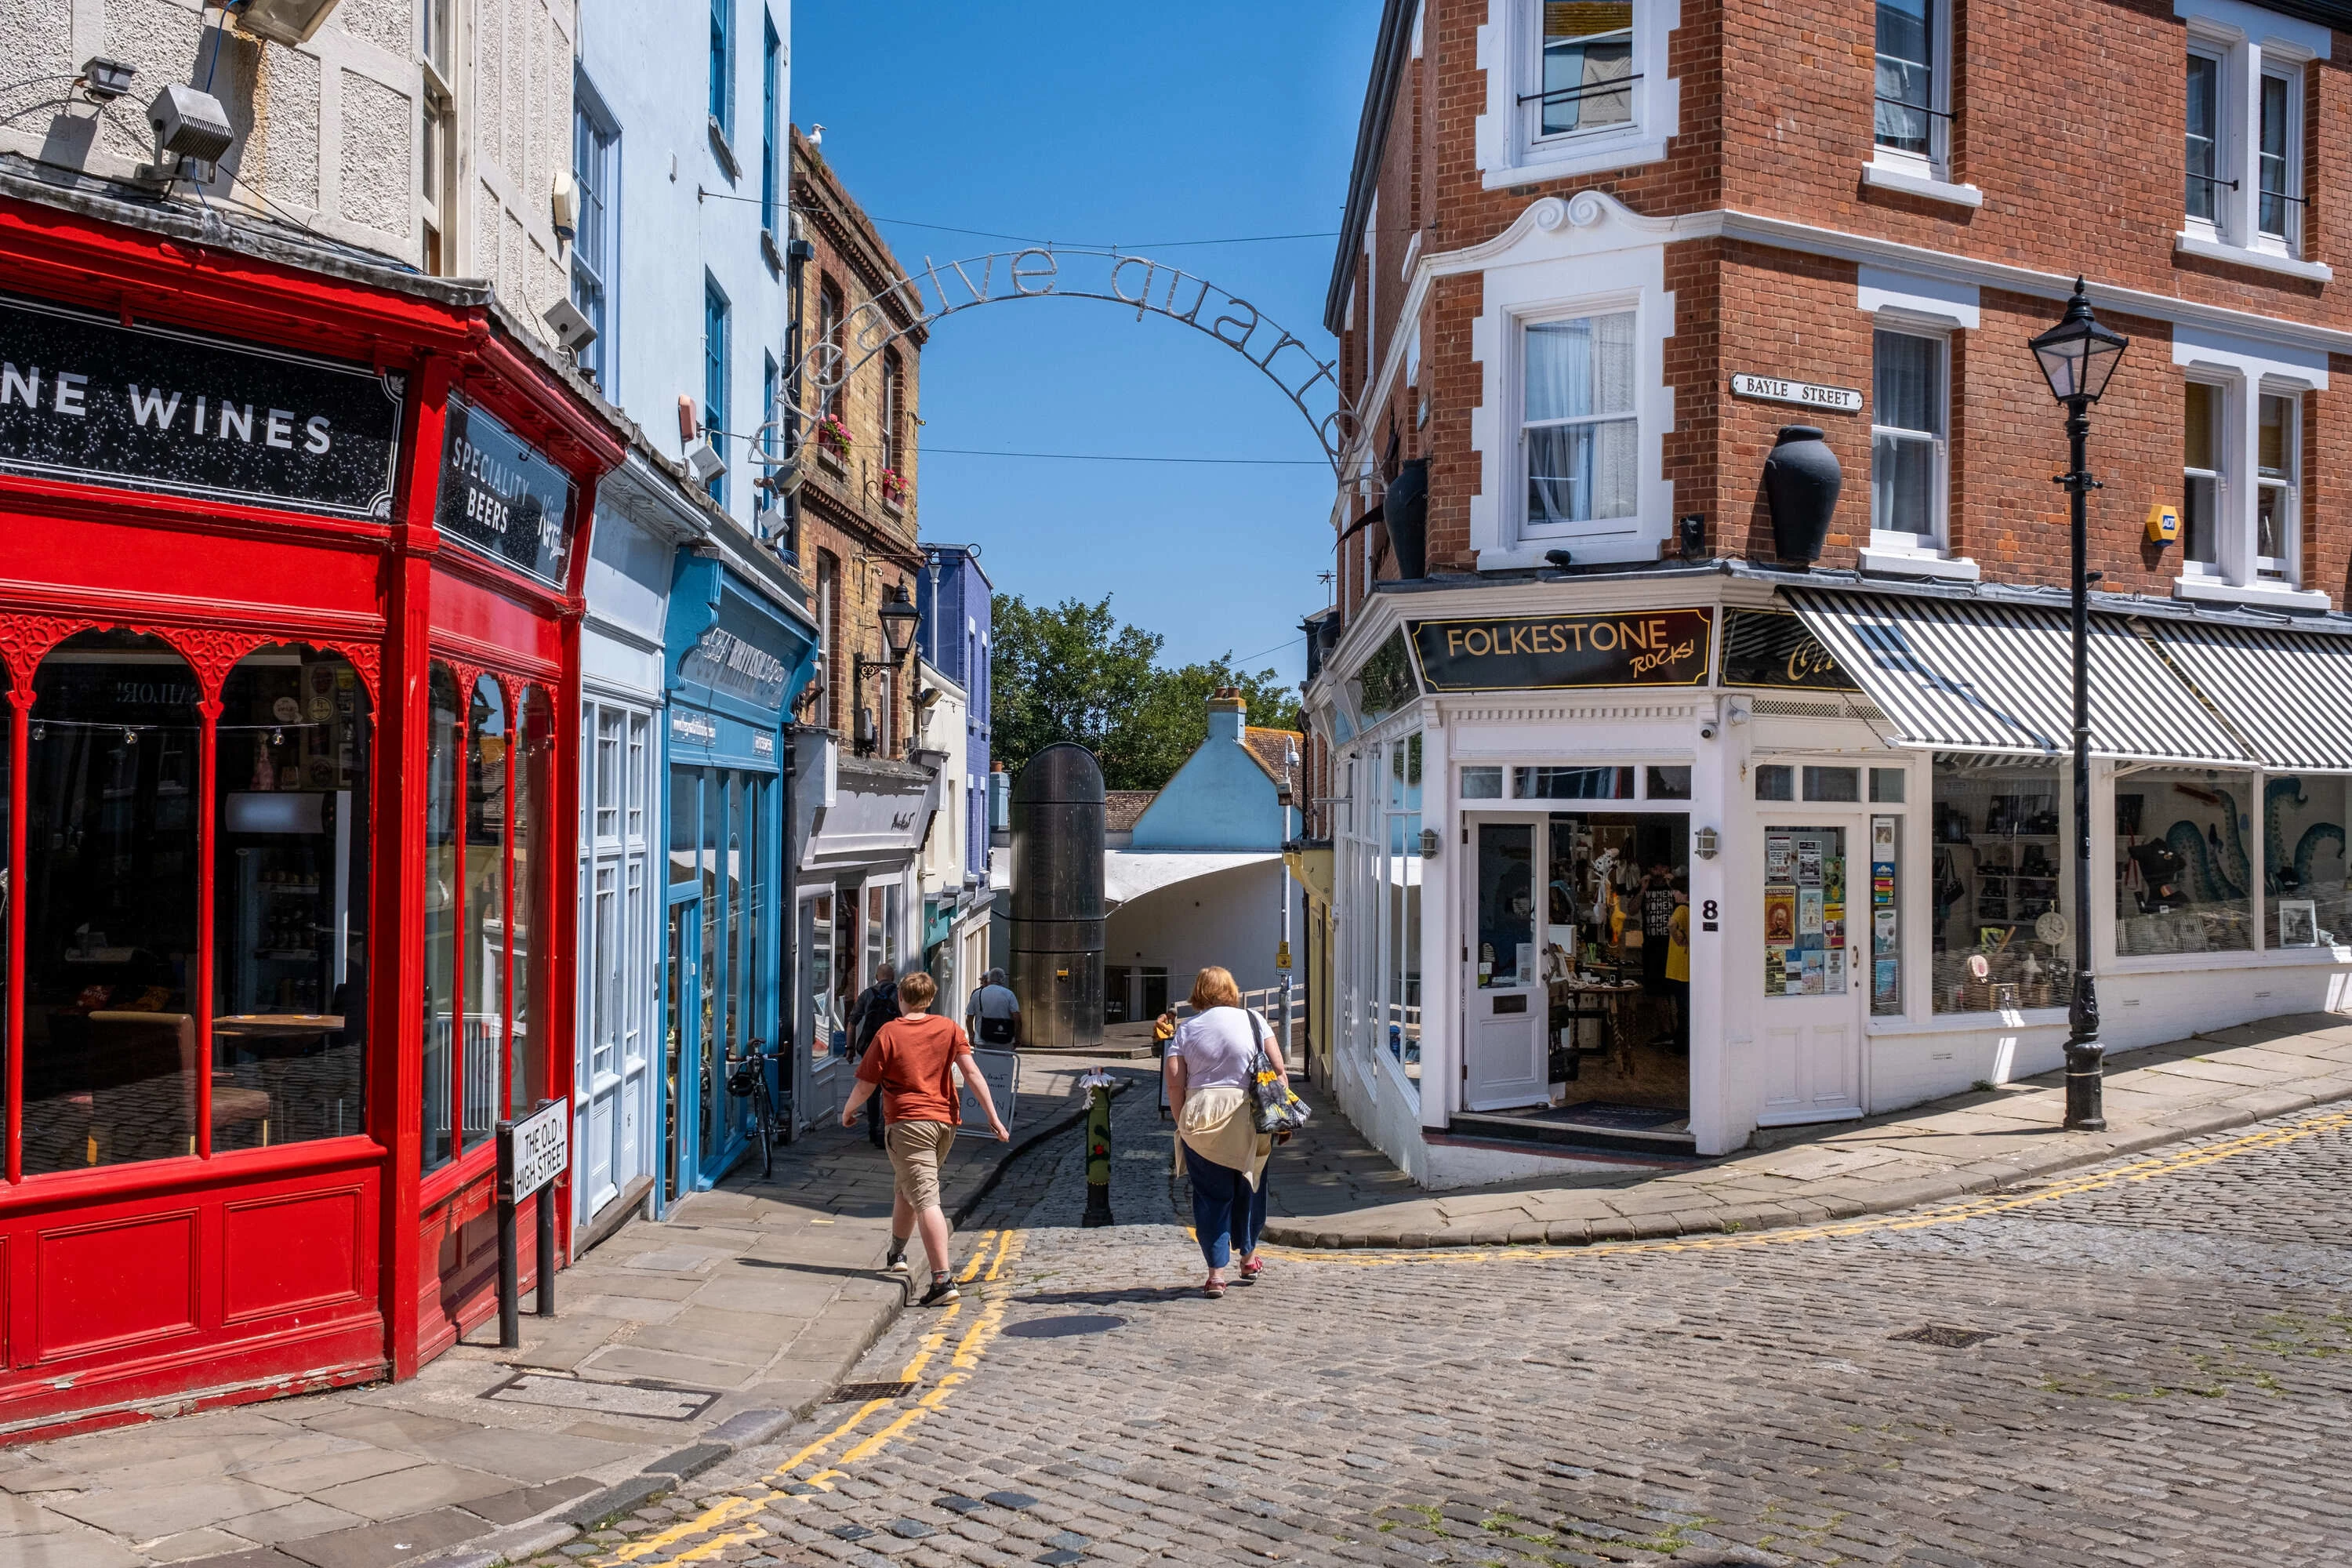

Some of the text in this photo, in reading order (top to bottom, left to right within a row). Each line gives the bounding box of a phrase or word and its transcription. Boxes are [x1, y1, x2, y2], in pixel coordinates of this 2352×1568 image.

[1747, 378, 1849, 405] BAYLE STREET
[128, 383, 331, 454] WINES
[453, 437, 529, 506] SPECIALITY
[466, 487, 508, 534] BEERS
[2163, 517, 2175, 528] ADT
[1447, 620, 1668, 657] FOLKESTONE
[1630, 639, 1694, 678] ROCKS!
[1645, 890, 1673, 898] WOMEN
[1703, 899, 1719, 920] 8
[967, 1098, 1004, 1110] ON
[525, 1128, 539, 1160] THE
[542, 1118, 557, 1149] OLD
[516, 1141, 565, 1197] HIGH STREET
